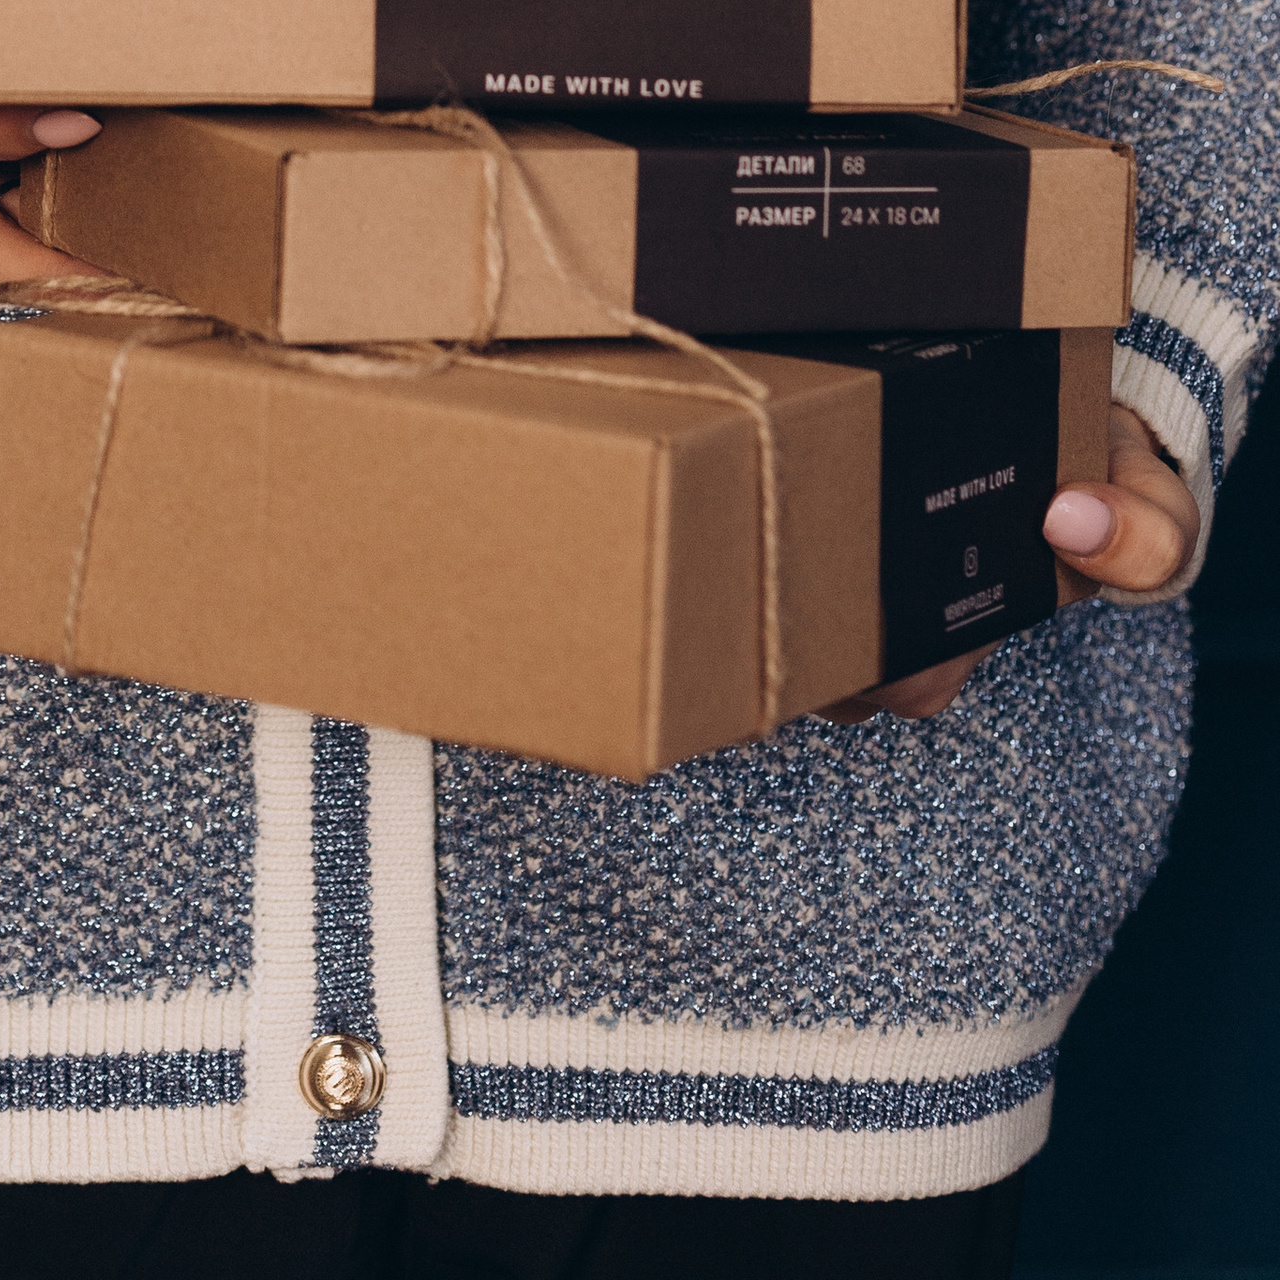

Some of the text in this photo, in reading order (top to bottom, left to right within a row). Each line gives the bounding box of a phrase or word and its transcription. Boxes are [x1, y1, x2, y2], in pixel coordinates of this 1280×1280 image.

[485, 73, 704, 99] MADE WITH LOVE
[736, 155, 866, 177] ДЕТАЛИ 68
[735, 206, 816, 226] РАЗМЕР
[841, 206, 864, 226] 24
[886, 206, 907, 226] 18
[924, 465, 1016, 514] MADE WITH LOVE
